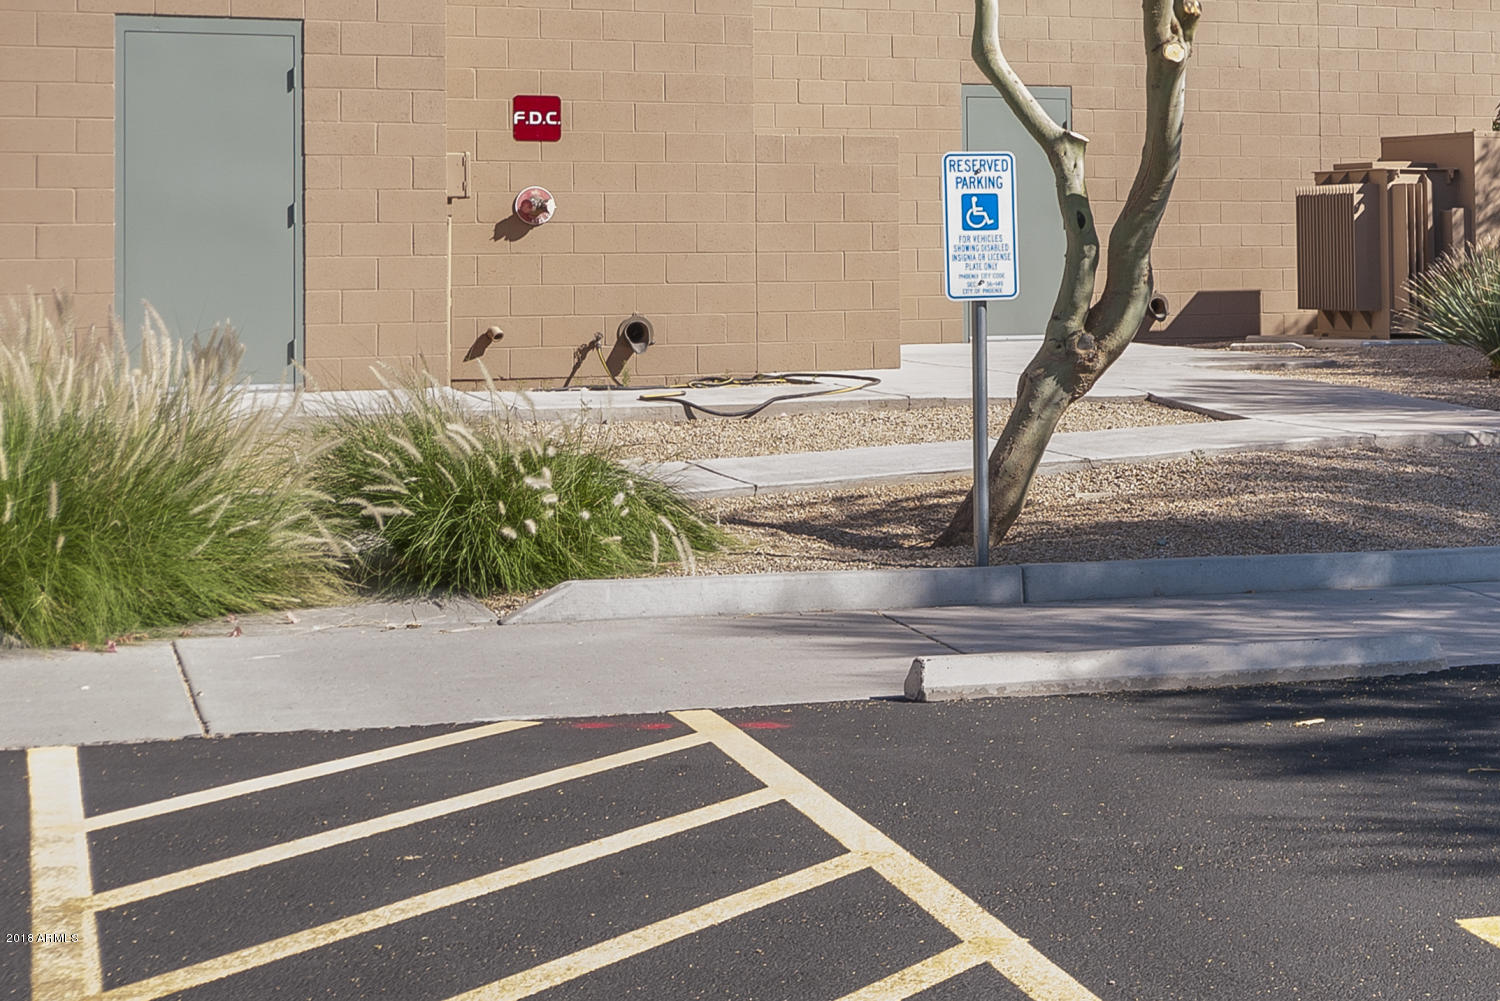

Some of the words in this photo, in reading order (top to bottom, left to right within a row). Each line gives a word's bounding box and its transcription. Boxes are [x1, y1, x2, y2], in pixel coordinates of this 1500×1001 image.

[513, 111, 561, 125] F.D.C.
[949, 159, 1009, 173] RESERVED
[955, 176, 1003, 190] PARKING
[958, 235, 971, 243] FOR
[973, 234, 1003, 243] VEHICLES
[953, 244, 980, 252] SHOWING
[981, 243, 1009, 252] DISABLED
[952, 254, 977, 262] INSIGNIA
[987, 252, 1011, 261] LICENSE
[965, 263, 982, 271] PLATE
[983, 262, 998, 270] ONLY
